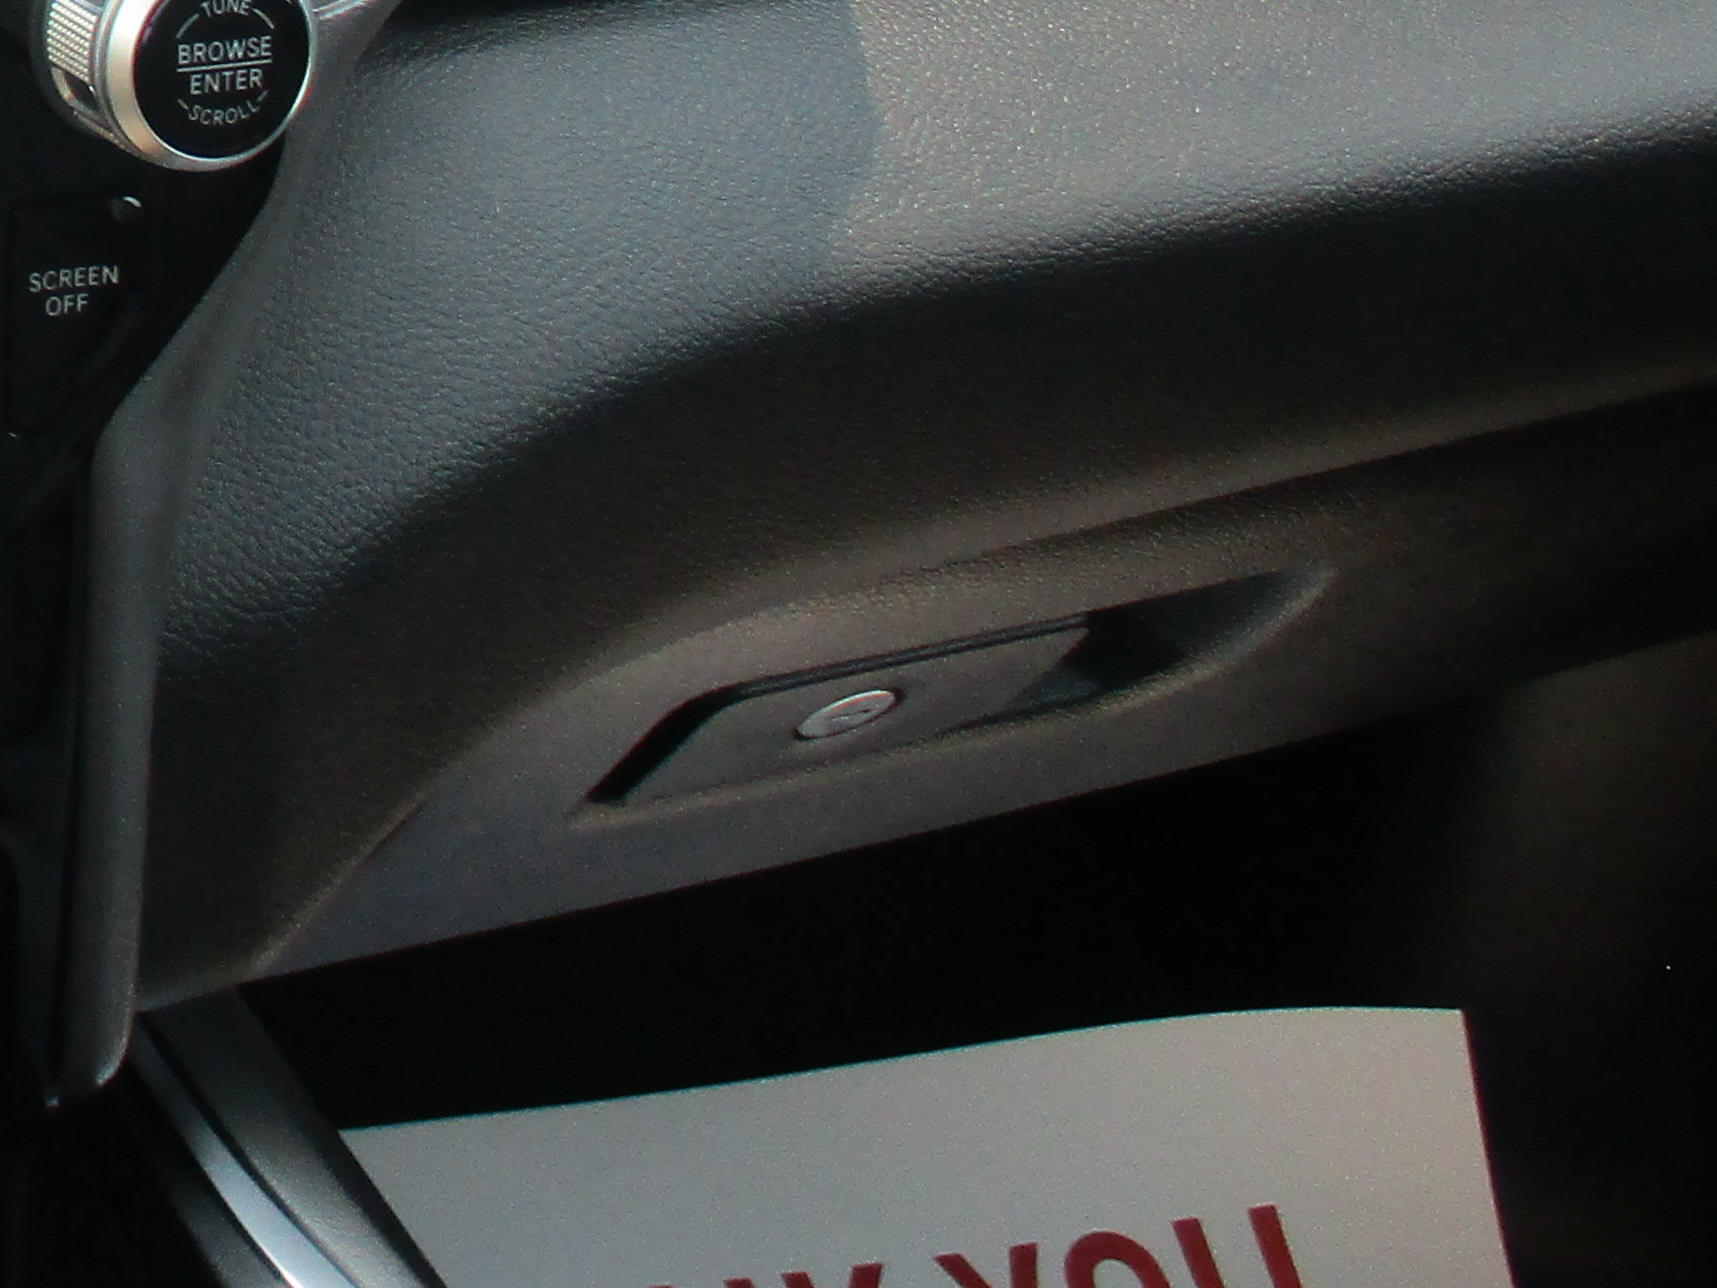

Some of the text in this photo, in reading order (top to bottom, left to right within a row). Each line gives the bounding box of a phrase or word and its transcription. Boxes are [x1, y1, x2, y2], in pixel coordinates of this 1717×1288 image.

[178, 34, 273, 65] BROWSE
[190, 68, 263, 95] ENTER
[188, 99, 260, 125] SCROLL
[28, 265, 120, 294] SCREEN
[45, 293, 89, 317] OFF
